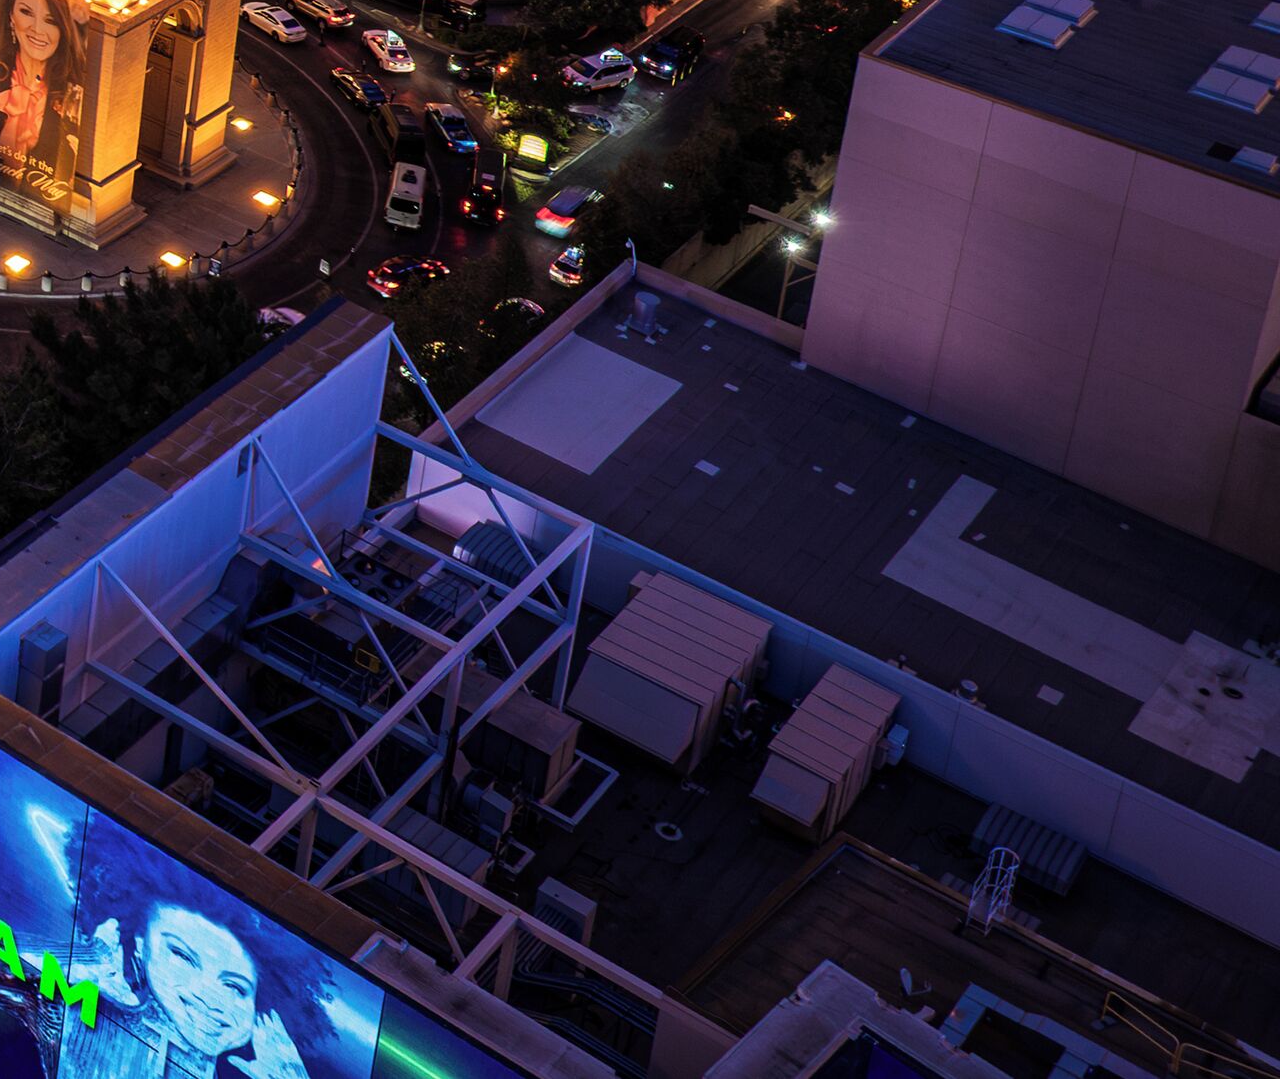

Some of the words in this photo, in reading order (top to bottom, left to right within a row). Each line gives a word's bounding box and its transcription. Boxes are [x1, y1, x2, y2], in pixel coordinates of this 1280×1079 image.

[13, 150, 27, 163] do
[28, 155, 37, 167] it
[38, 160, 54, 175] the
[26, 170, 73, 201] Way
